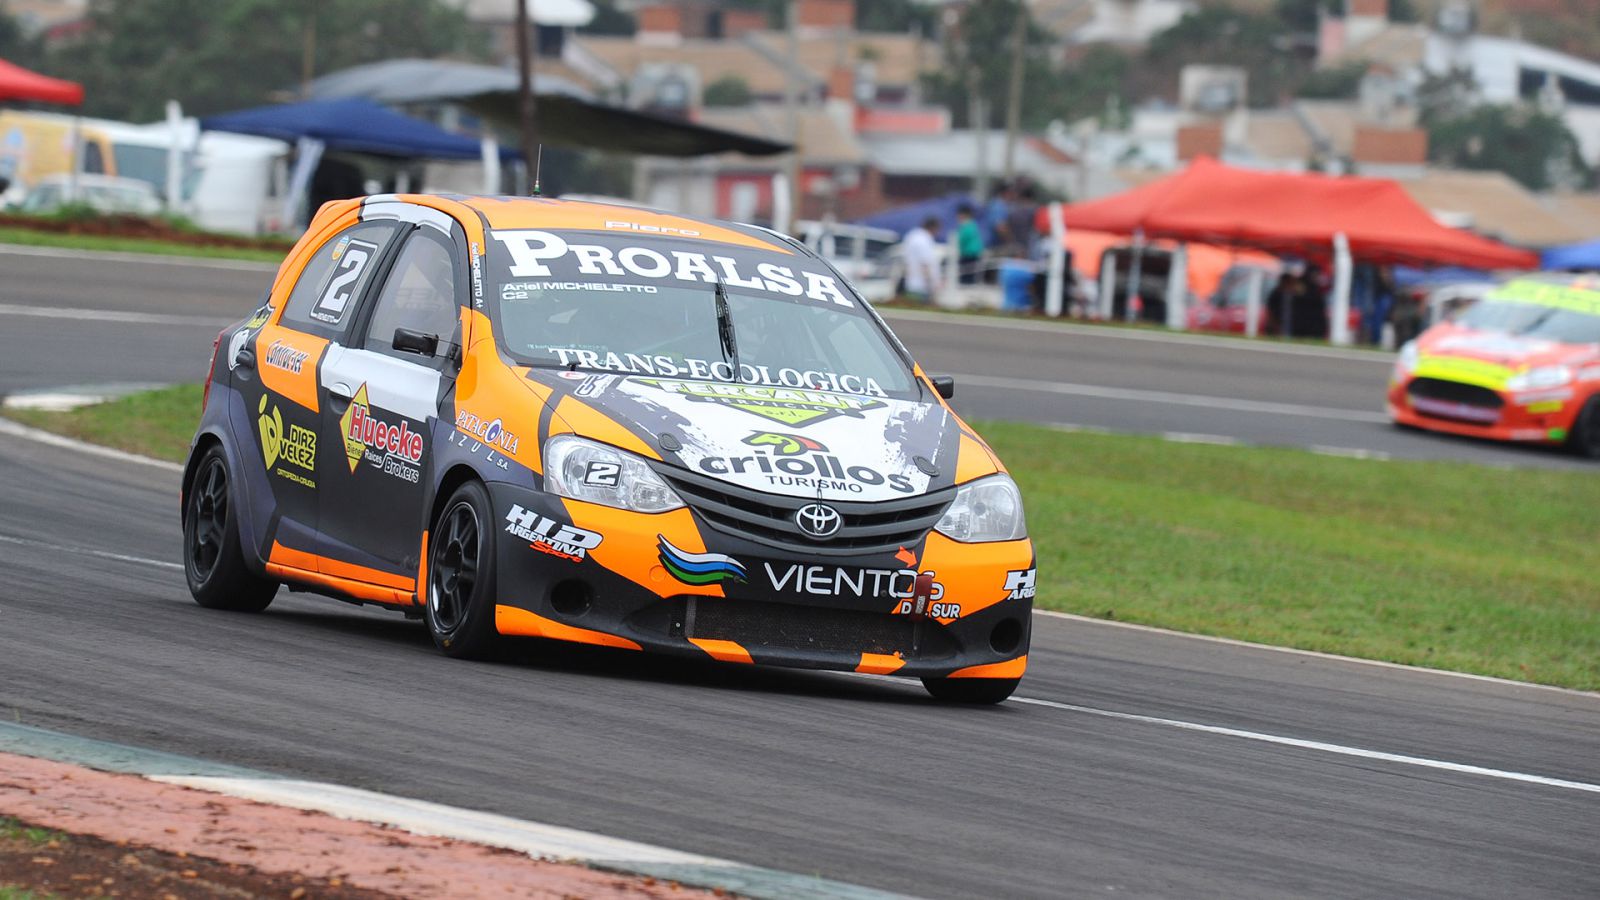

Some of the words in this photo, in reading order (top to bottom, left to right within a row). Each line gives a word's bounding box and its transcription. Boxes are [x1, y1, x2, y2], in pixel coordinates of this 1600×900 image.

[604, 219, 701, 237] Piero
[319, 249, 368, 312] 2
[490, 230, 855, 307] PROALSA
[502, 283, 540, 292] Ariel
[542, 283, 657, 294] MICHIELETTO
[502, 291, 528, 300] C2
[548, 347, 888, 397] TRANS-ECOLOGICA
[703, 396, 846, 415] SERVICIOS
[291, 425, 316, 450] DIAZ
[349, 403, 423, 462] Huecke
[454, 410, 520, 455] PATAGONIA
[280, 440, 314, 468] VELEZ
[384, 456, 420, 484] Brokers
[587, 463, 619, 485] 2
[699, 451, 915, 493] criollos
[765, 475, 863, 493] TURISMO
[505, 523, 586, 559] ARGENTINA
[932, 603, 961, 618] SUR
